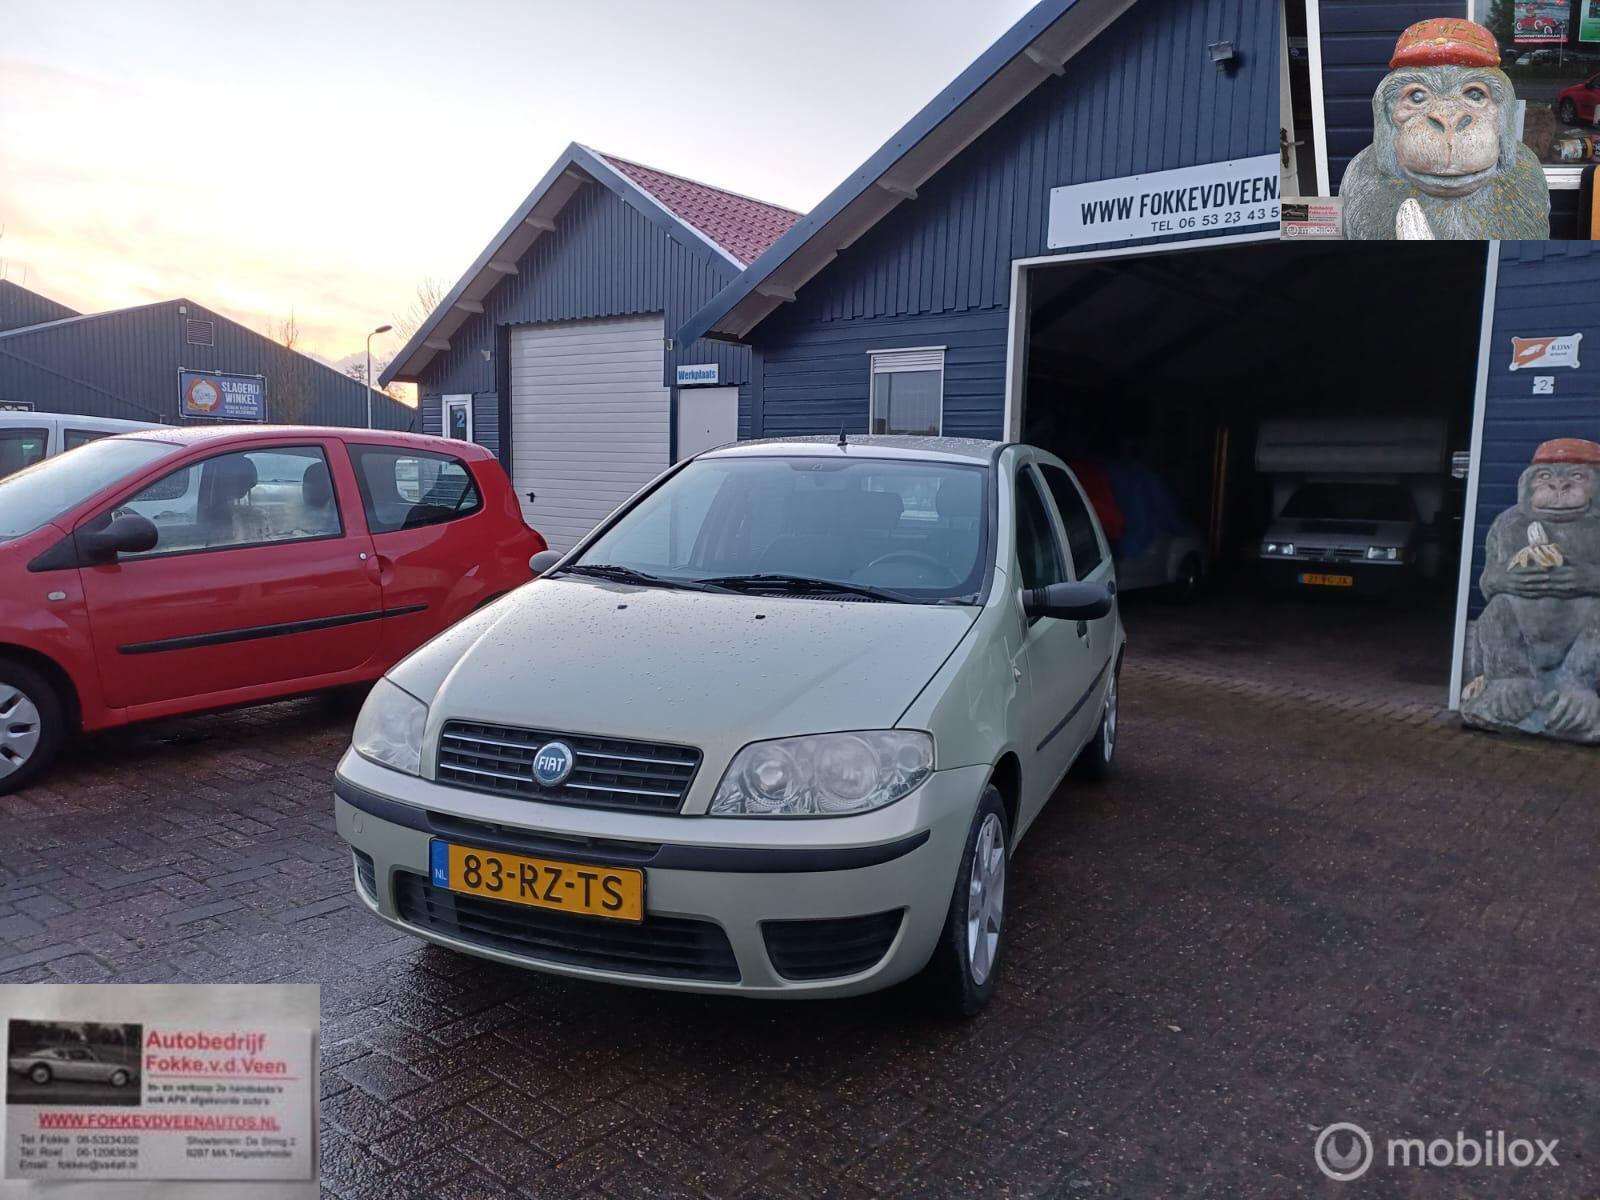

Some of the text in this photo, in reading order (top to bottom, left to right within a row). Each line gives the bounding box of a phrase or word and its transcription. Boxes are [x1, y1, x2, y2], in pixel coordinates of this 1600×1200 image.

[1081, 196, 1134, 225] WWW
[1151, 221, 1174, 233] TEL
[1178, 217, 1196, 229] 06
[1202, 213, 1219, 226] 53
[1224, 211, 1242, 225] 23
[1247, 208, 1266, 221] 43
[678, 369, 716, 381] Werkplaats
[221, 381, 260, 394] SLAGERIJ
[1539, 379, 1548, 391] 2
[225, 393, 257, 405] WINKEL
[456, 410, 465, 428] 2
[537, 755, 566, 772] FIAT
[434, 868, 447, 881] NL
[463, 854, 623, 911] 83-RZ-TS
